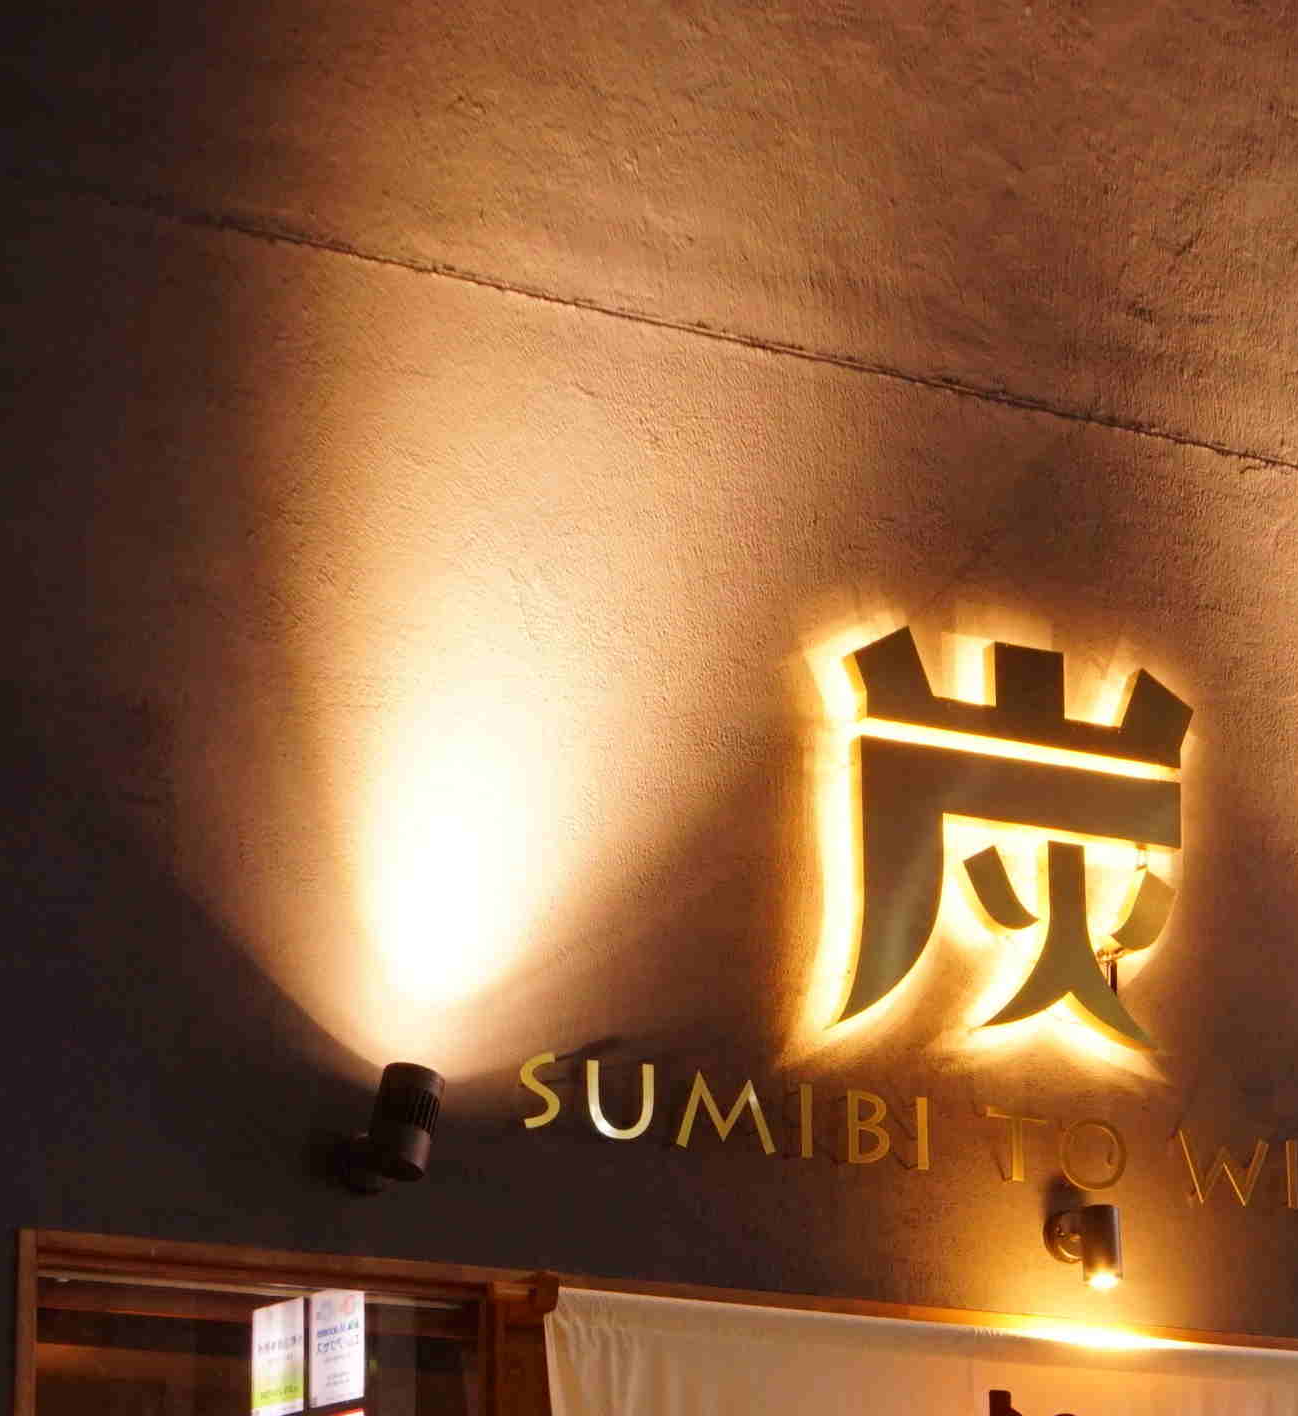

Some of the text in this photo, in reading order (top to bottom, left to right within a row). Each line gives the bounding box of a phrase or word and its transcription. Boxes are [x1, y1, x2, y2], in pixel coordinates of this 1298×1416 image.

[824, 625, 1194, 1050] 炭
[518, 1052, 932, 1171] SUMIBI
[986, 1104, 1127, 1192] TO
